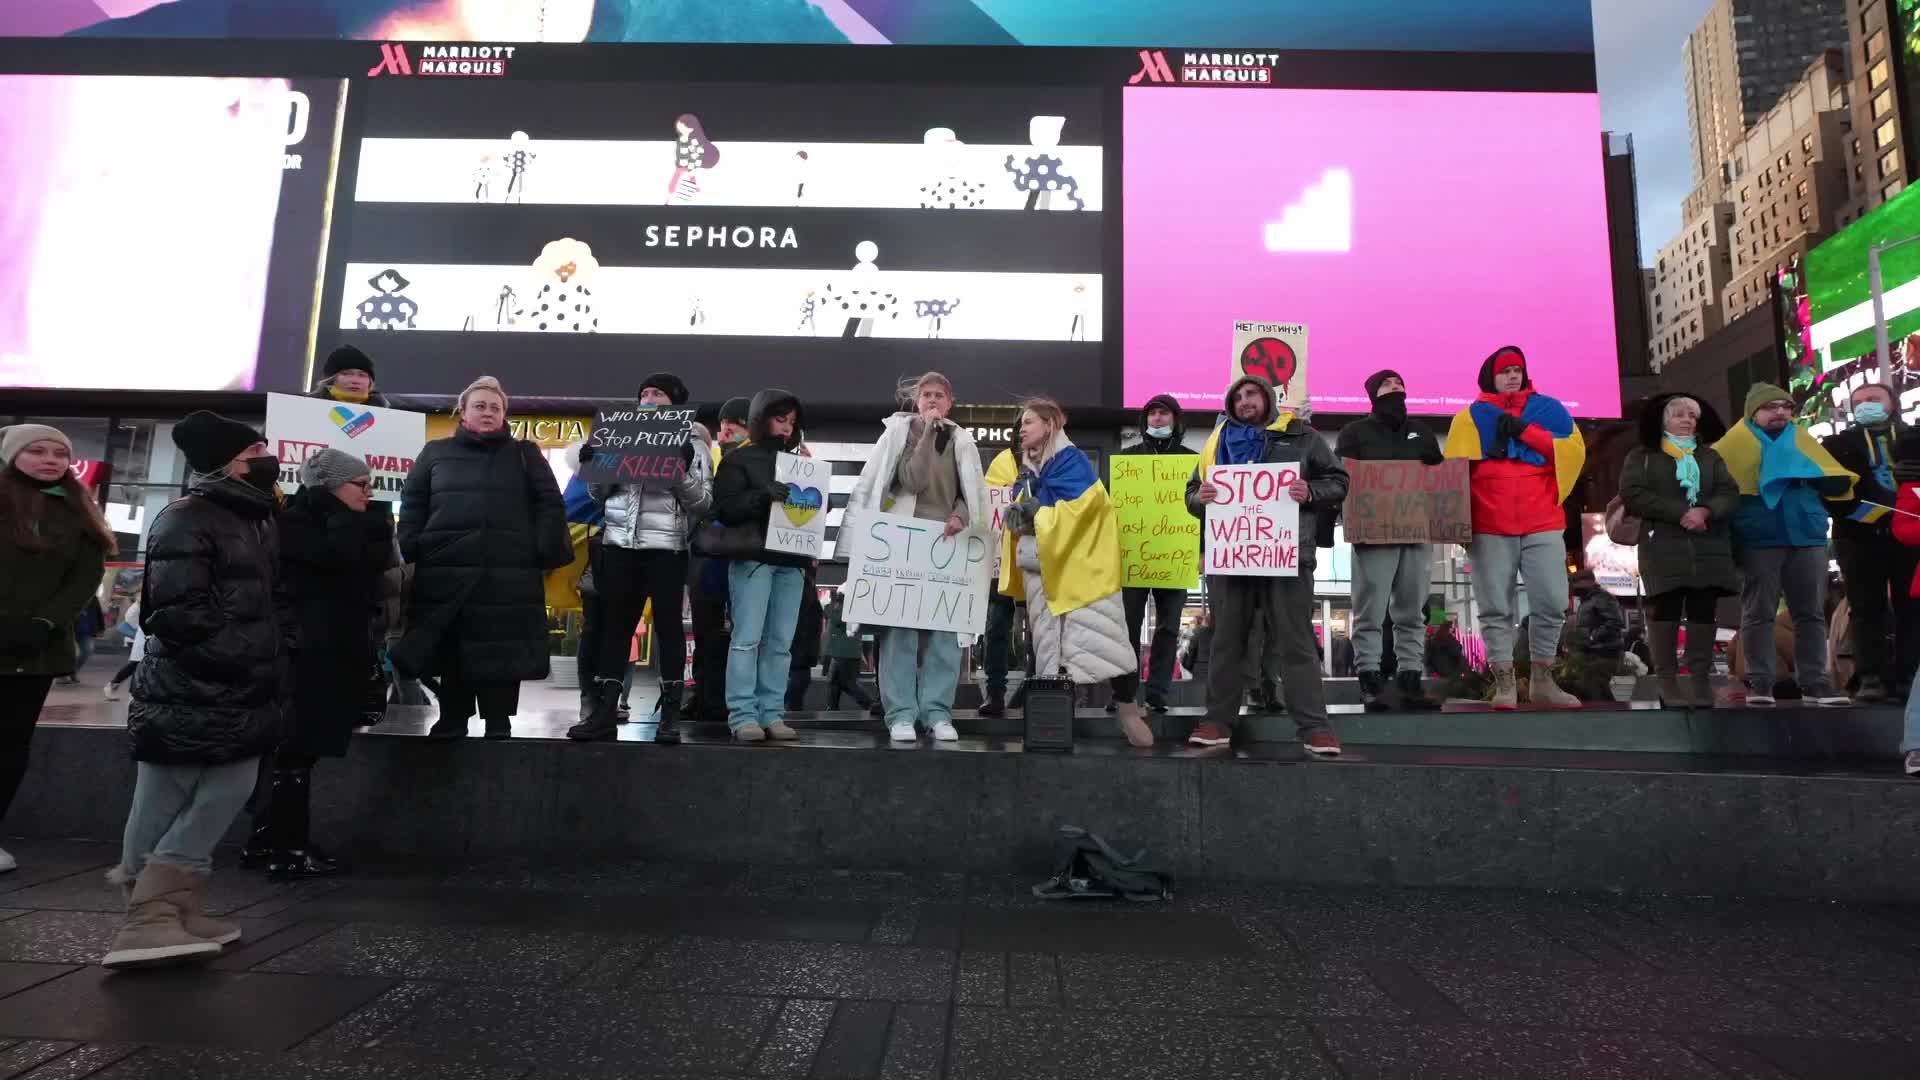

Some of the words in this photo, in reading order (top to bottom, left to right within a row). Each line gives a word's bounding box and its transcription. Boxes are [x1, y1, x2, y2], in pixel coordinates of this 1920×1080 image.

[423, 46, 516, 58] MARRIOTT
[1184, 53, 1280, 66] MARRIOTT
[421, 61, 502, 74] MARQUIS
[1184, 69, 1268, 82] MARQUIS
[645, 225, 799, 249] SEPHORA
[1235, 322, 1254, 332] НЕТ
[600, 411, 634, 423] WHO
[636, 411, 649, 421] IS
[652, 409, 696, 421] NEXT
[508, 419, 585, 442] VICTA
[591, 427, 632, 449] Stop
[790, 459, 815, 477] NO
[1212, 469, 1297, 505] STOP
[1154, 489, 1185, 505] Wa
[1241, 504, 1264, 515] THE
[1152, 514, 1200, 536] chance
[776, 530, 816, 551] WAR
[865, 521, 986, 576] STOP
[1140, 540, 1194, 565] Europe
[1213, 543, 1298, 569] UKRAINE
